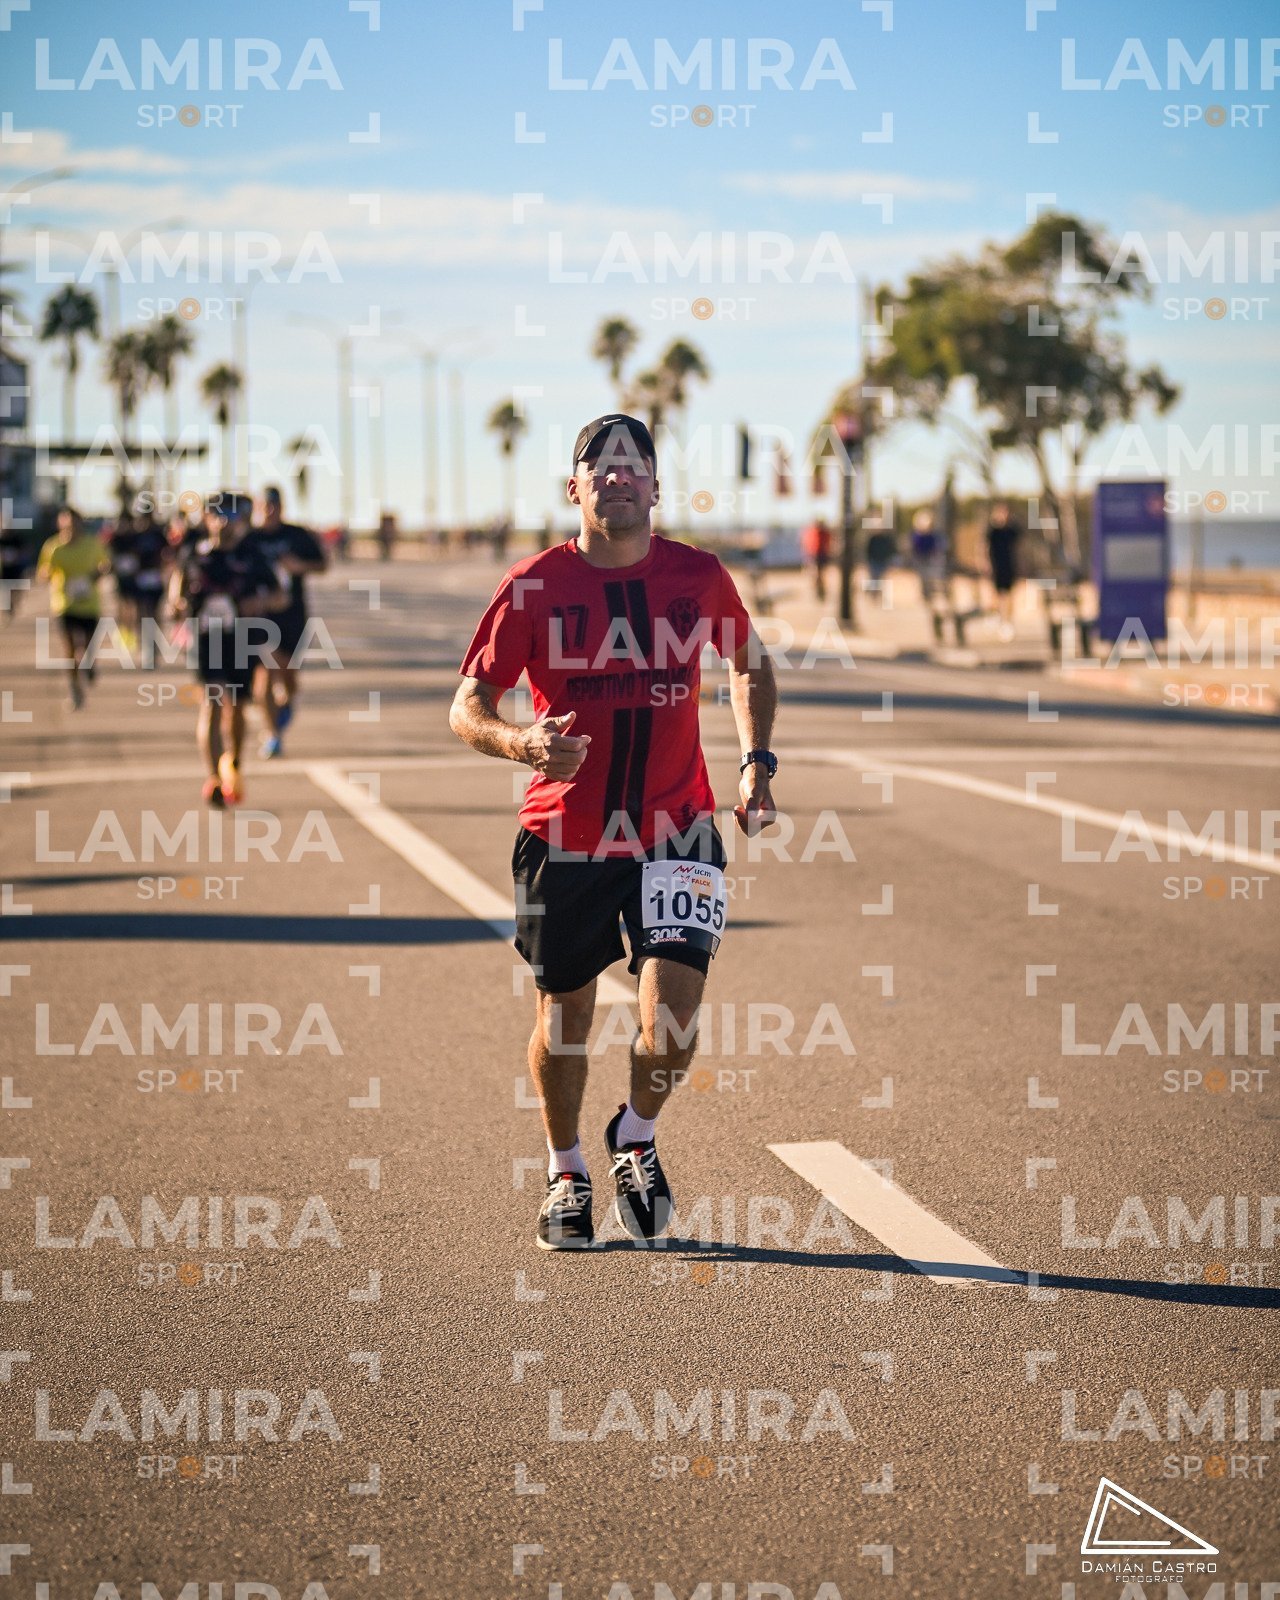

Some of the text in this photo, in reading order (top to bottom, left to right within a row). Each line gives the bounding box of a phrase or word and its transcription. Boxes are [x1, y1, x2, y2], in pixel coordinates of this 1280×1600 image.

[552, 604, 588, 650] 17
[694, 868, 711, 877] ucm
[650, 890, 724, 930] 1055
[650, 927, 684, 944] 30K
